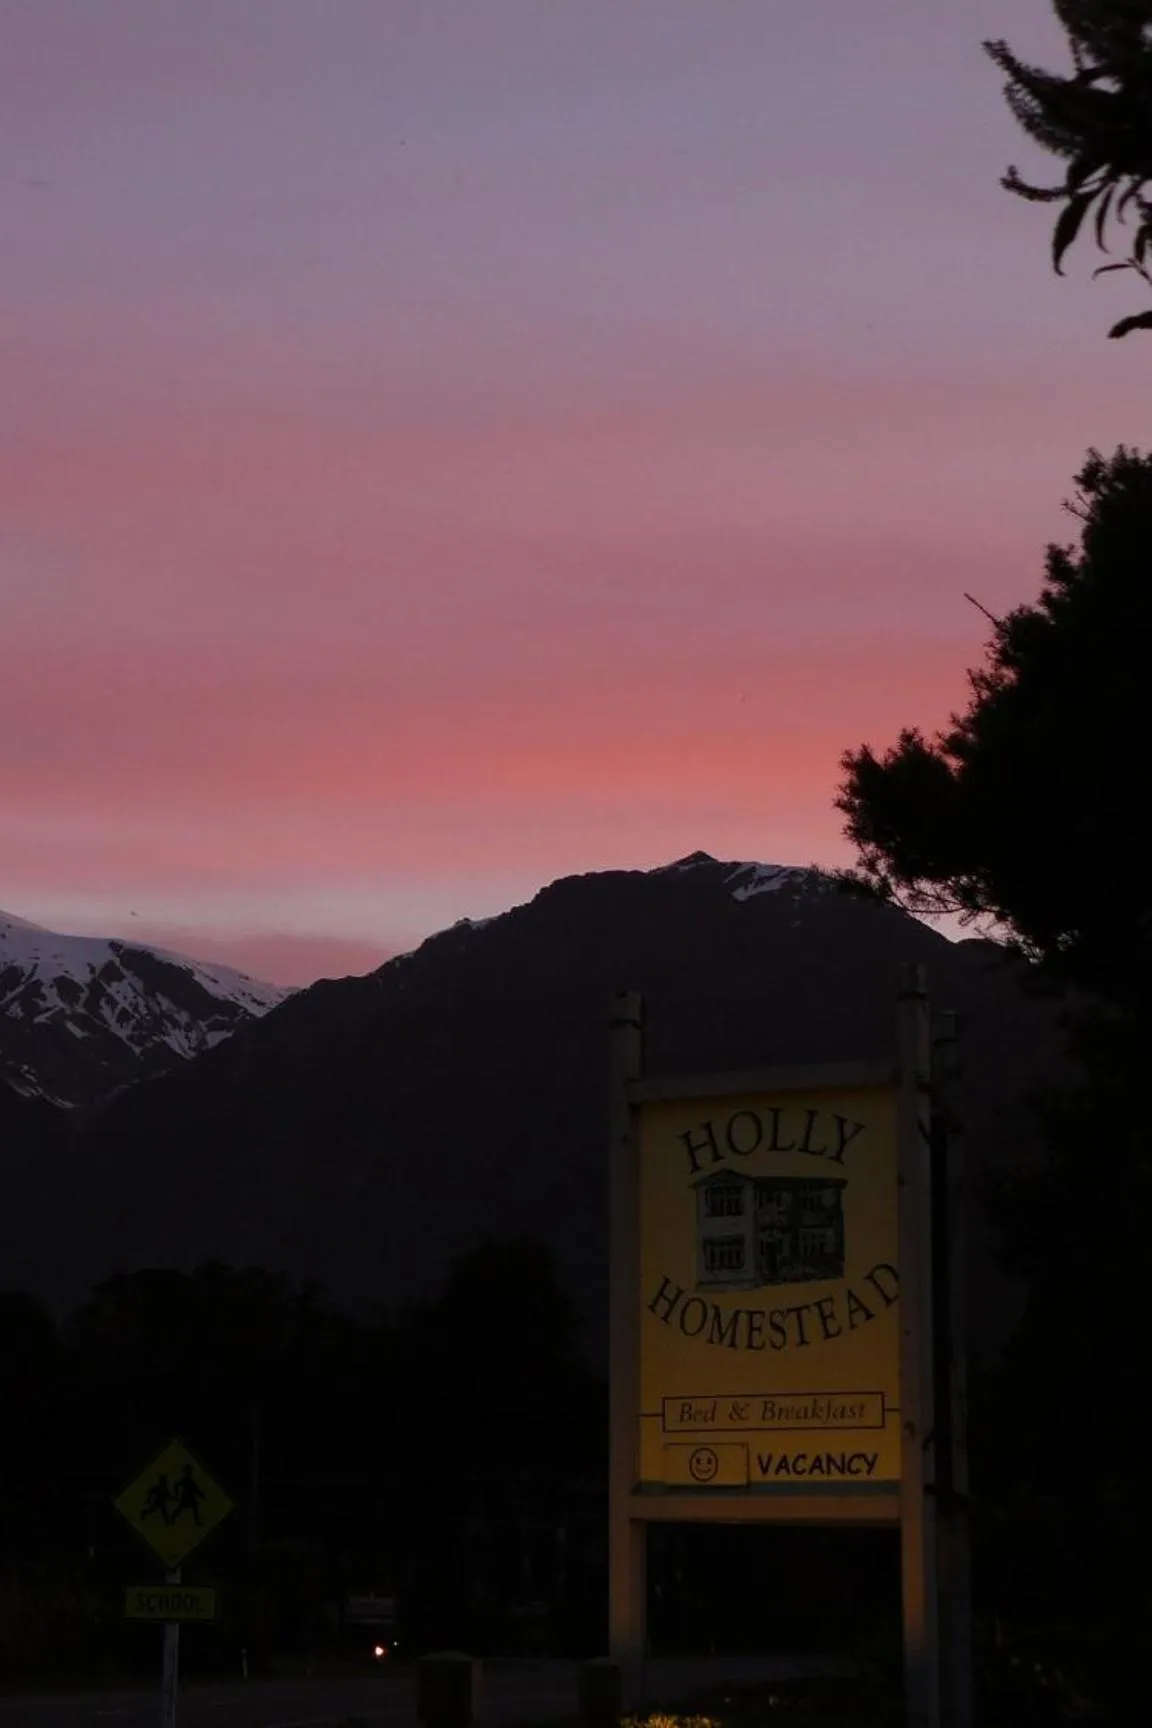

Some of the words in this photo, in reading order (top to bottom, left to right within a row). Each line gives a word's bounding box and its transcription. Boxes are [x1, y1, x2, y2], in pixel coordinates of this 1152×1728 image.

[677, 1107, 866, 1174] HOLLY
[648, 1262, 901, 1352] HOMESTEAD
[679, 1400, 716, 1423] Bed
[728, 1400, 749, 1422] &
[761, 1397, 866, 1423] Breakfast
[757, 1452, 878, 1476] VACANCY
[135, 1590, 204, 1614] SCHOOL
